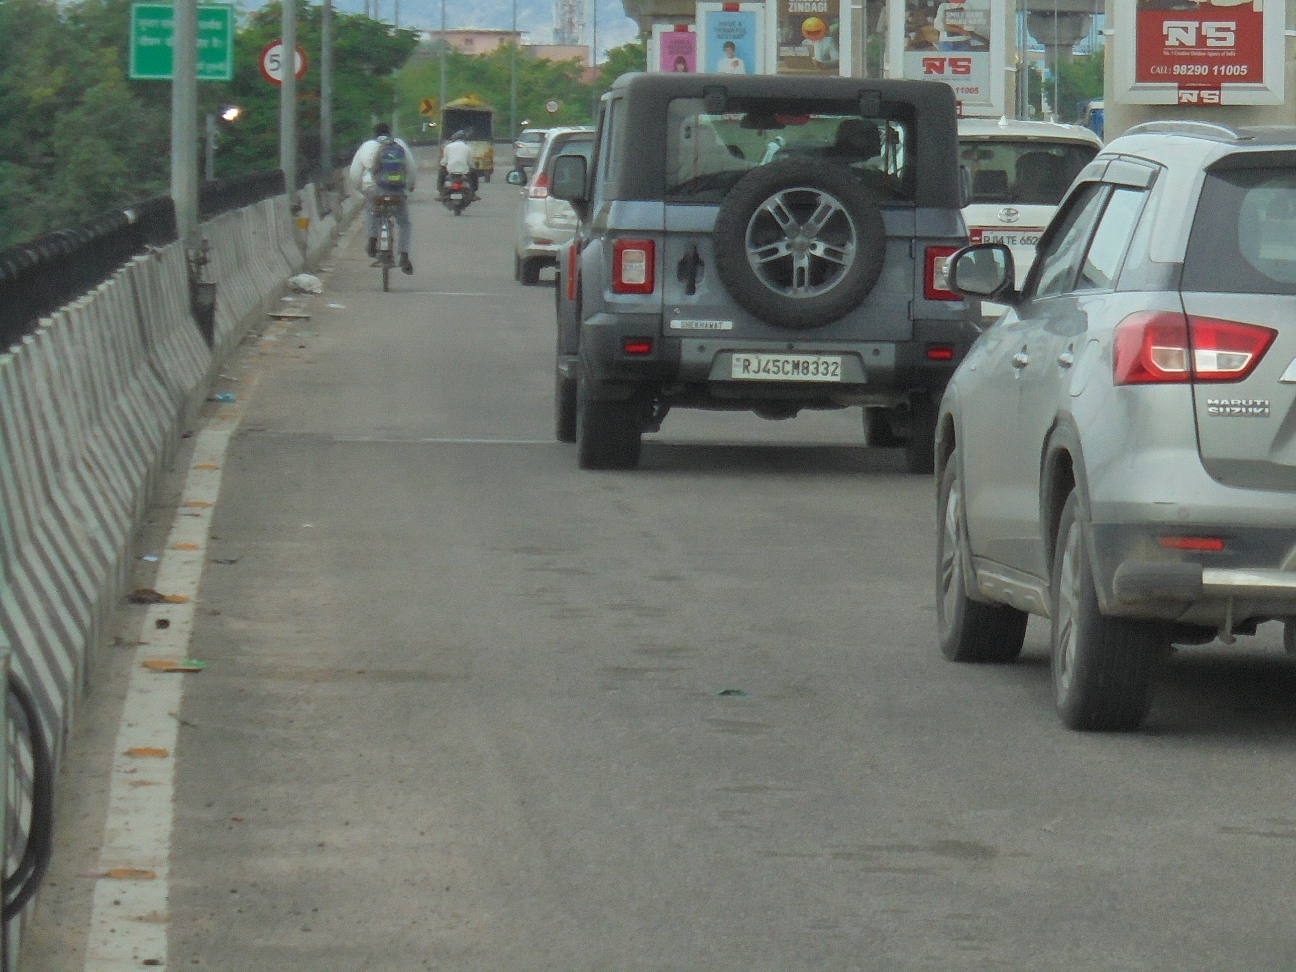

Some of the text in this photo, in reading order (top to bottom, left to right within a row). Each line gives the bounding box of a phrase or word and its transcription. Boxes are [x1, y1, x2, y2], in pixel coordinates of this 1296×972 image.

[1162, 21, 1237, 46] NS
[922, 57, 972, 75] NS
[1173, 64, 1209, 76] 98290
[1212, 64, 1248, 76] 11005
[1019, 236, 1041, 246] 652
[742, 358, 839, 378] RJ45CM8332
[1207, 398, 1270, 406] MARUTI
[1208, 406, 1270, 416] SUZUKI
